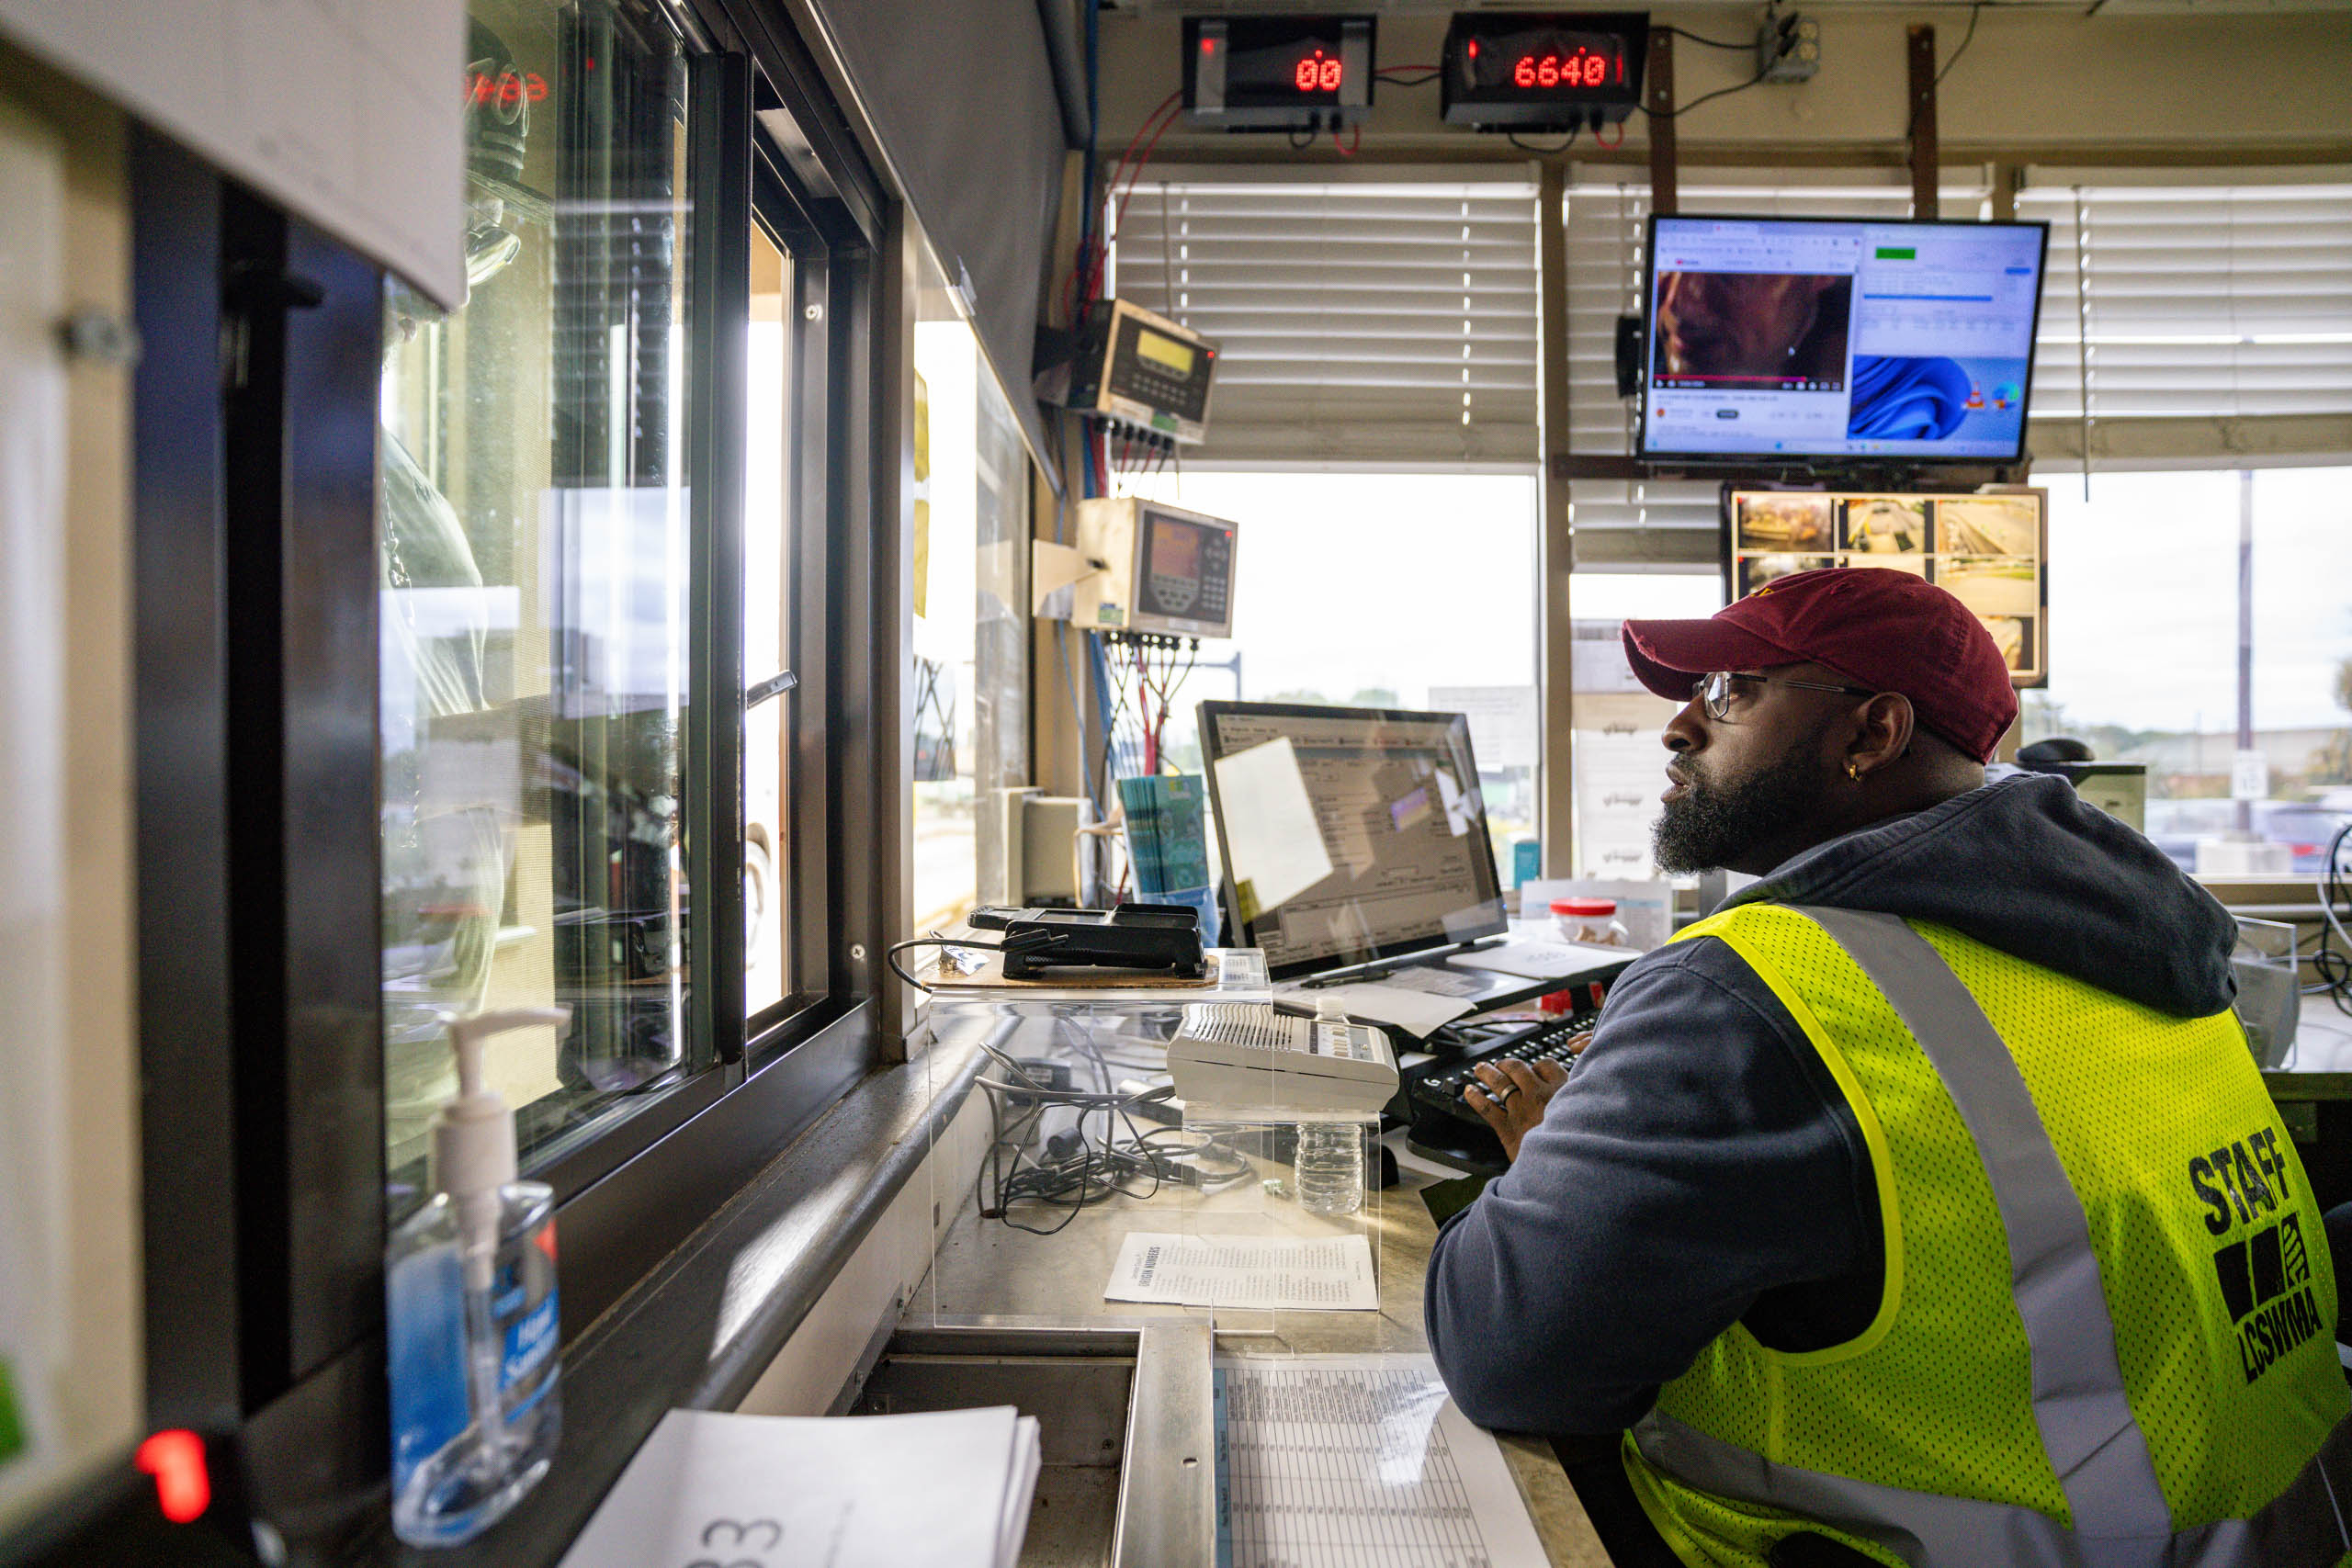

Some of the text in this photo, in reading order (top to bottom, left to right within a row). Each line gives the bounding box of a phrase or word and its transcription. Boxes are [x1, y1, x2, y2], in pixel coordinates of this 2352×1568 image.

[1295, 60, 1342, 91] 00
[1515, 56, 1605, 87] 6640
[2188, 1126, 2290, 1235] STAFF
[1144, 1247, 1160, 1269] NUMBERS
[2236, 1286, 2324, 1384] LCSWMA
